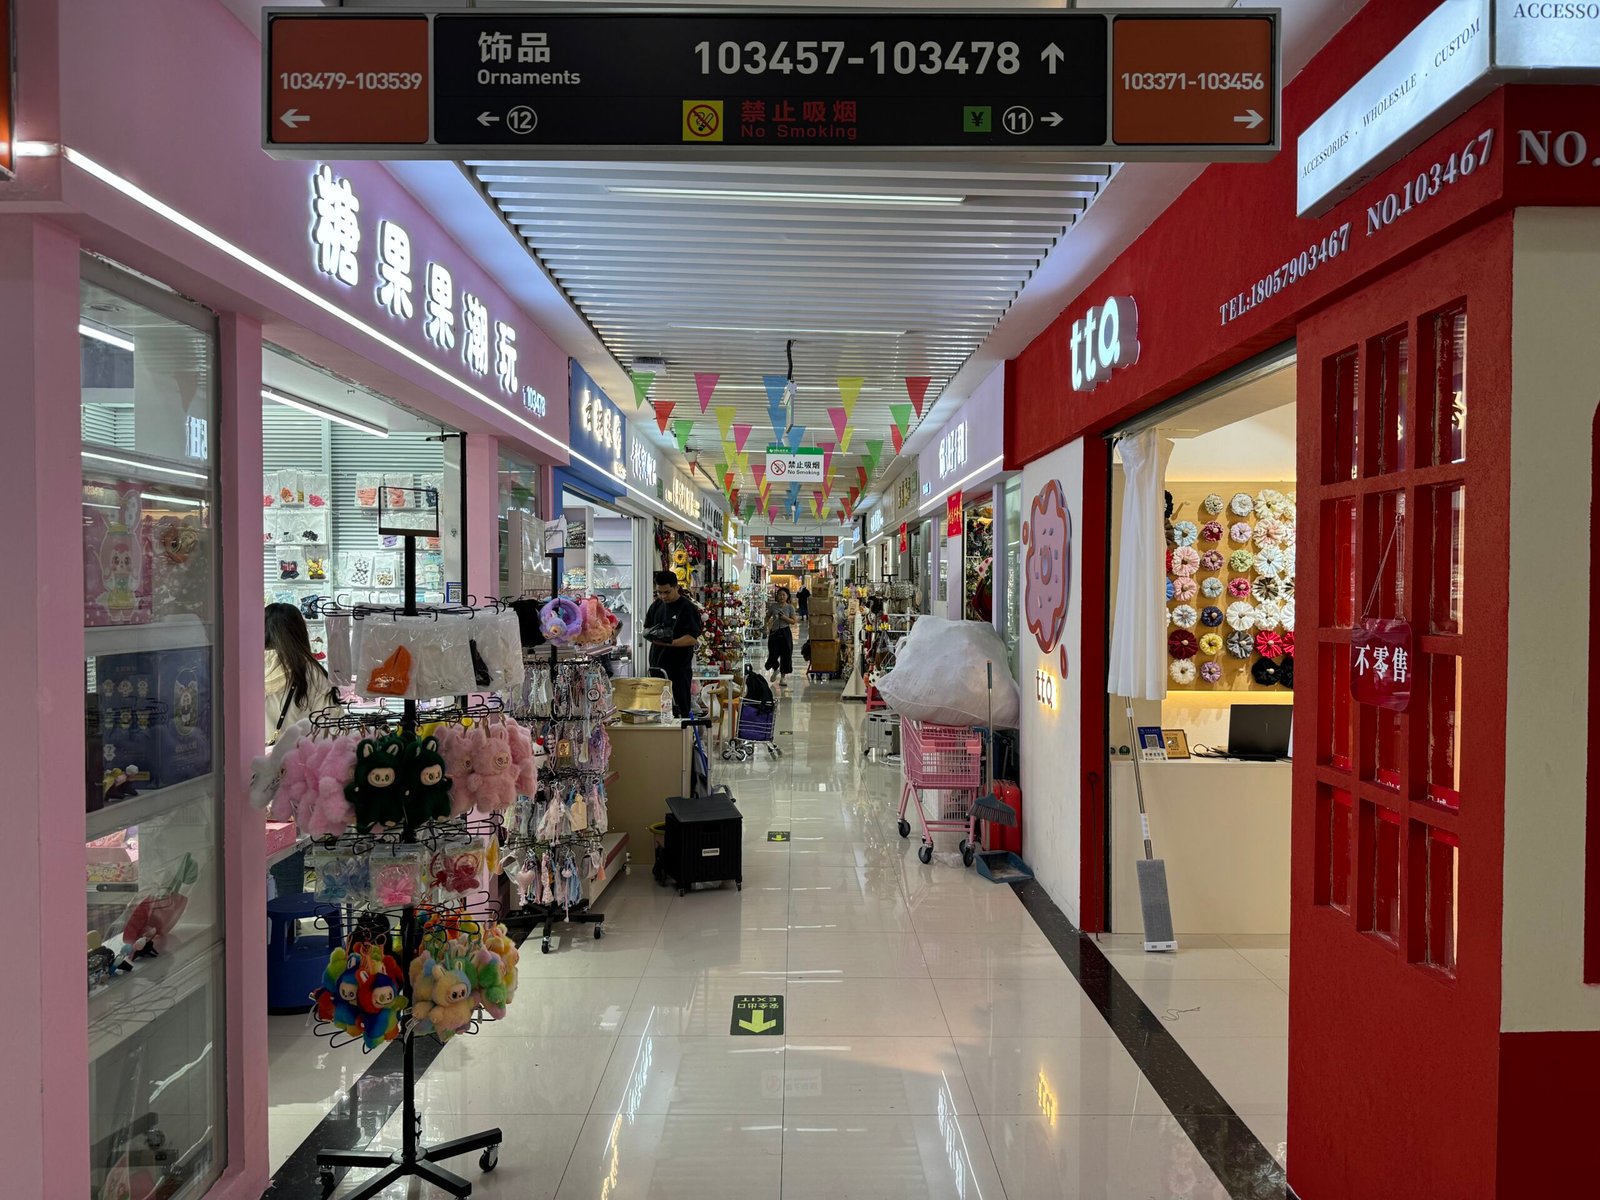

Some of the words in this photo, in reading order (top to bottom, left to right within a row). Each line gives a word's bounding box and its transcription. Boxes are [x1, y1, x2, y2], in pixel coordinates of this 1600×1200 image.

[1513, 3, 1600, 19] ACCESSO
[478, 31, 551, 63] 饰品
[694, 41, 1020, 75] 103457-103478
[280, 72, 422, 90] 103479-103539
[477, 69, 581, 85] Ornaments
[1121, 72, 1264, 91] 103371-103456
[1302, 130, 1349, 179] ACCESSORIES
[1362, 73, 1417, 128] WHOLESALE
[1434, 17, 1481, 69] CUSTOM
[509, 111, 532, 128] 12
[741, 100, 857, 122] 禁止吸烟
[1008, 111, 1028, 129] 11
[741, 125, 766, 138] No
[776, 124, 858, 140] Smoking
[1219, 222, 1352, 325] TEL:18057903467
[1365, 128, 1494, 236] NO.103467
[312, 164, 518, 393] 糖果果潮玩
[788, 460, 820, 470] 禁止吸烟
[1354, 644, 1408, 683] 不零售
